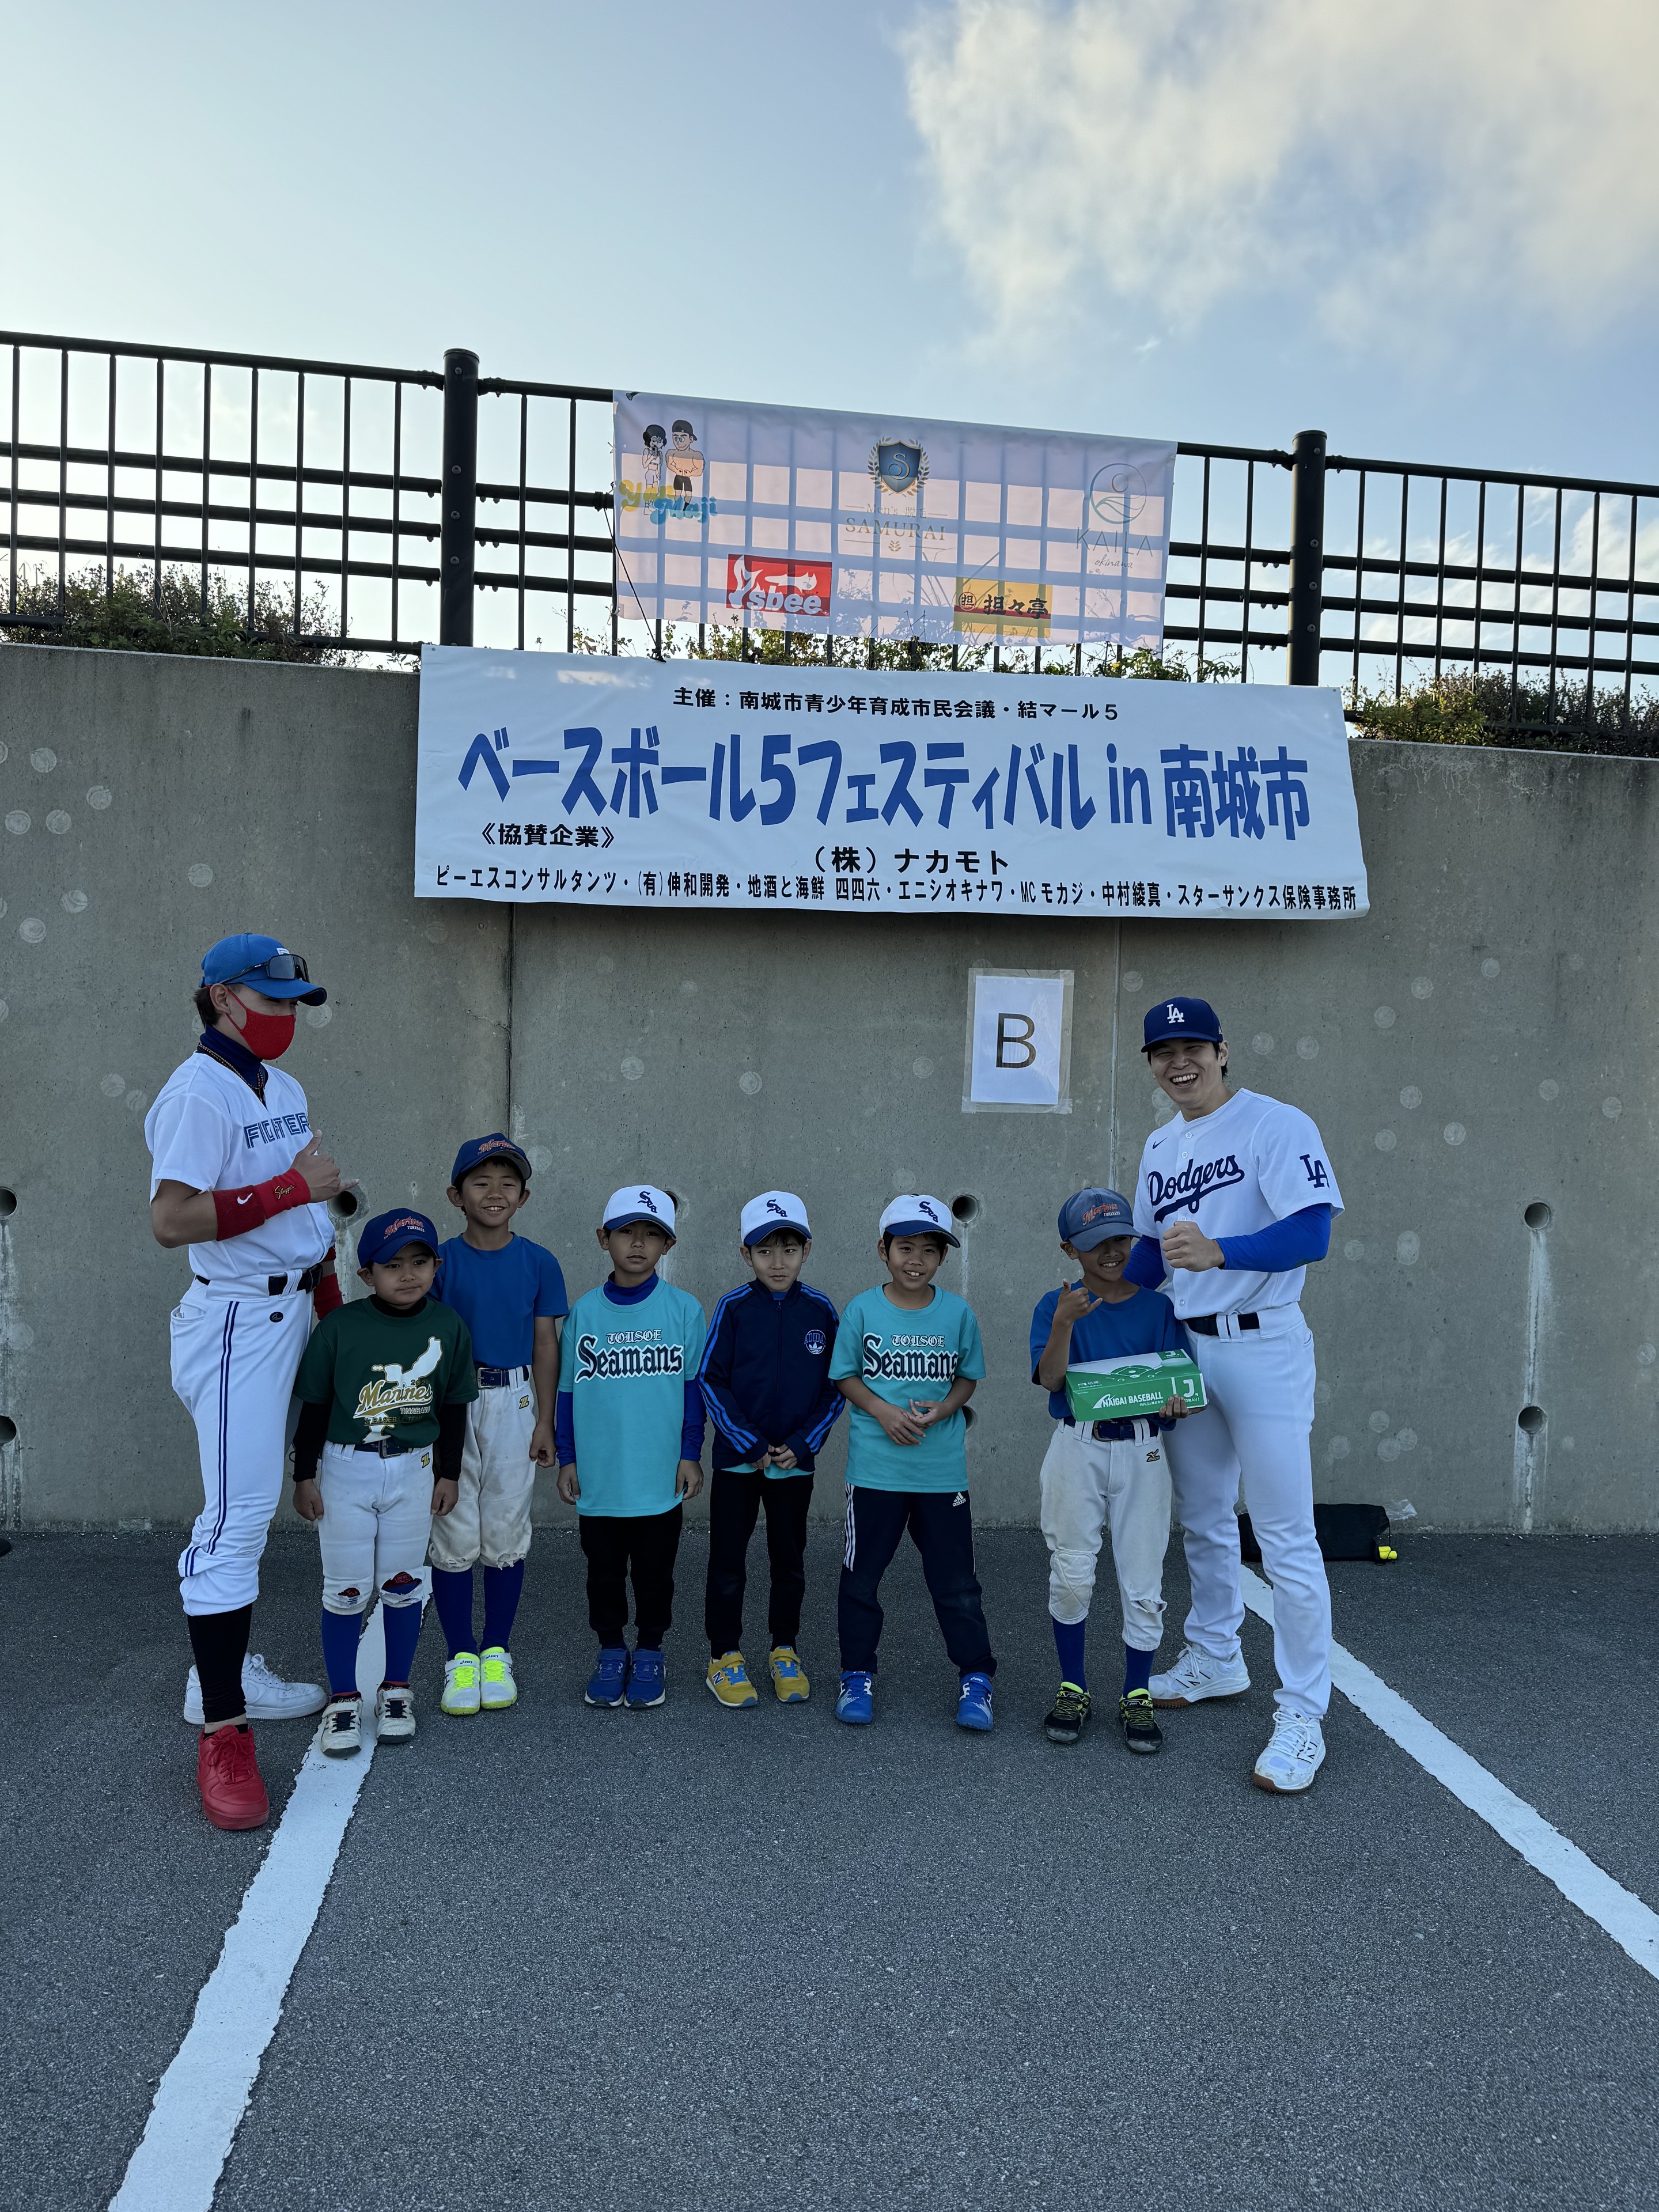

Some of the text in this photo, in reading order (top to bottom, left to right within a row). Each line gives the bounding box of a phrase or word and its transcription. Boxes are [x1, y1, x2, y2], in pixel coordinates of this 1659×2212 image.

[866, 503, 898, 516] Men's
[845, 517, 945, 541] SAMURAI
[1076, 527, 1153, 557] KAILA
[1094, 554, 1134, 569] okinawa
[983, 594, 1048, 619] 担々亭
[457, 725, 1310, 840] ベースボール5フェスティバル in 南城市
[482, 823, 615, 849] 《協賛企業》
[1166, 1003, 1185, 1024] LA
[995, 1012, 1036, 1069] B
[1299, 1154, 1330, 1188] LA
[1147, 1154, 1245, 1214] Dodgers
[637, 1191, 658, 1214] Sea
[766, 1199, 788, 1218] Sea
[918, 1201, 939, 1223] Sea
[1082, 1202, 1119, 1226] Marines
[804, 1332, 826, 1347] ADIDA
[574, 1334, 684, 1383] Seamans
[354, 1379, 433, 1416] Marines
[1101, 1392, 1164, 1408] NAIGAI BASEBALL
